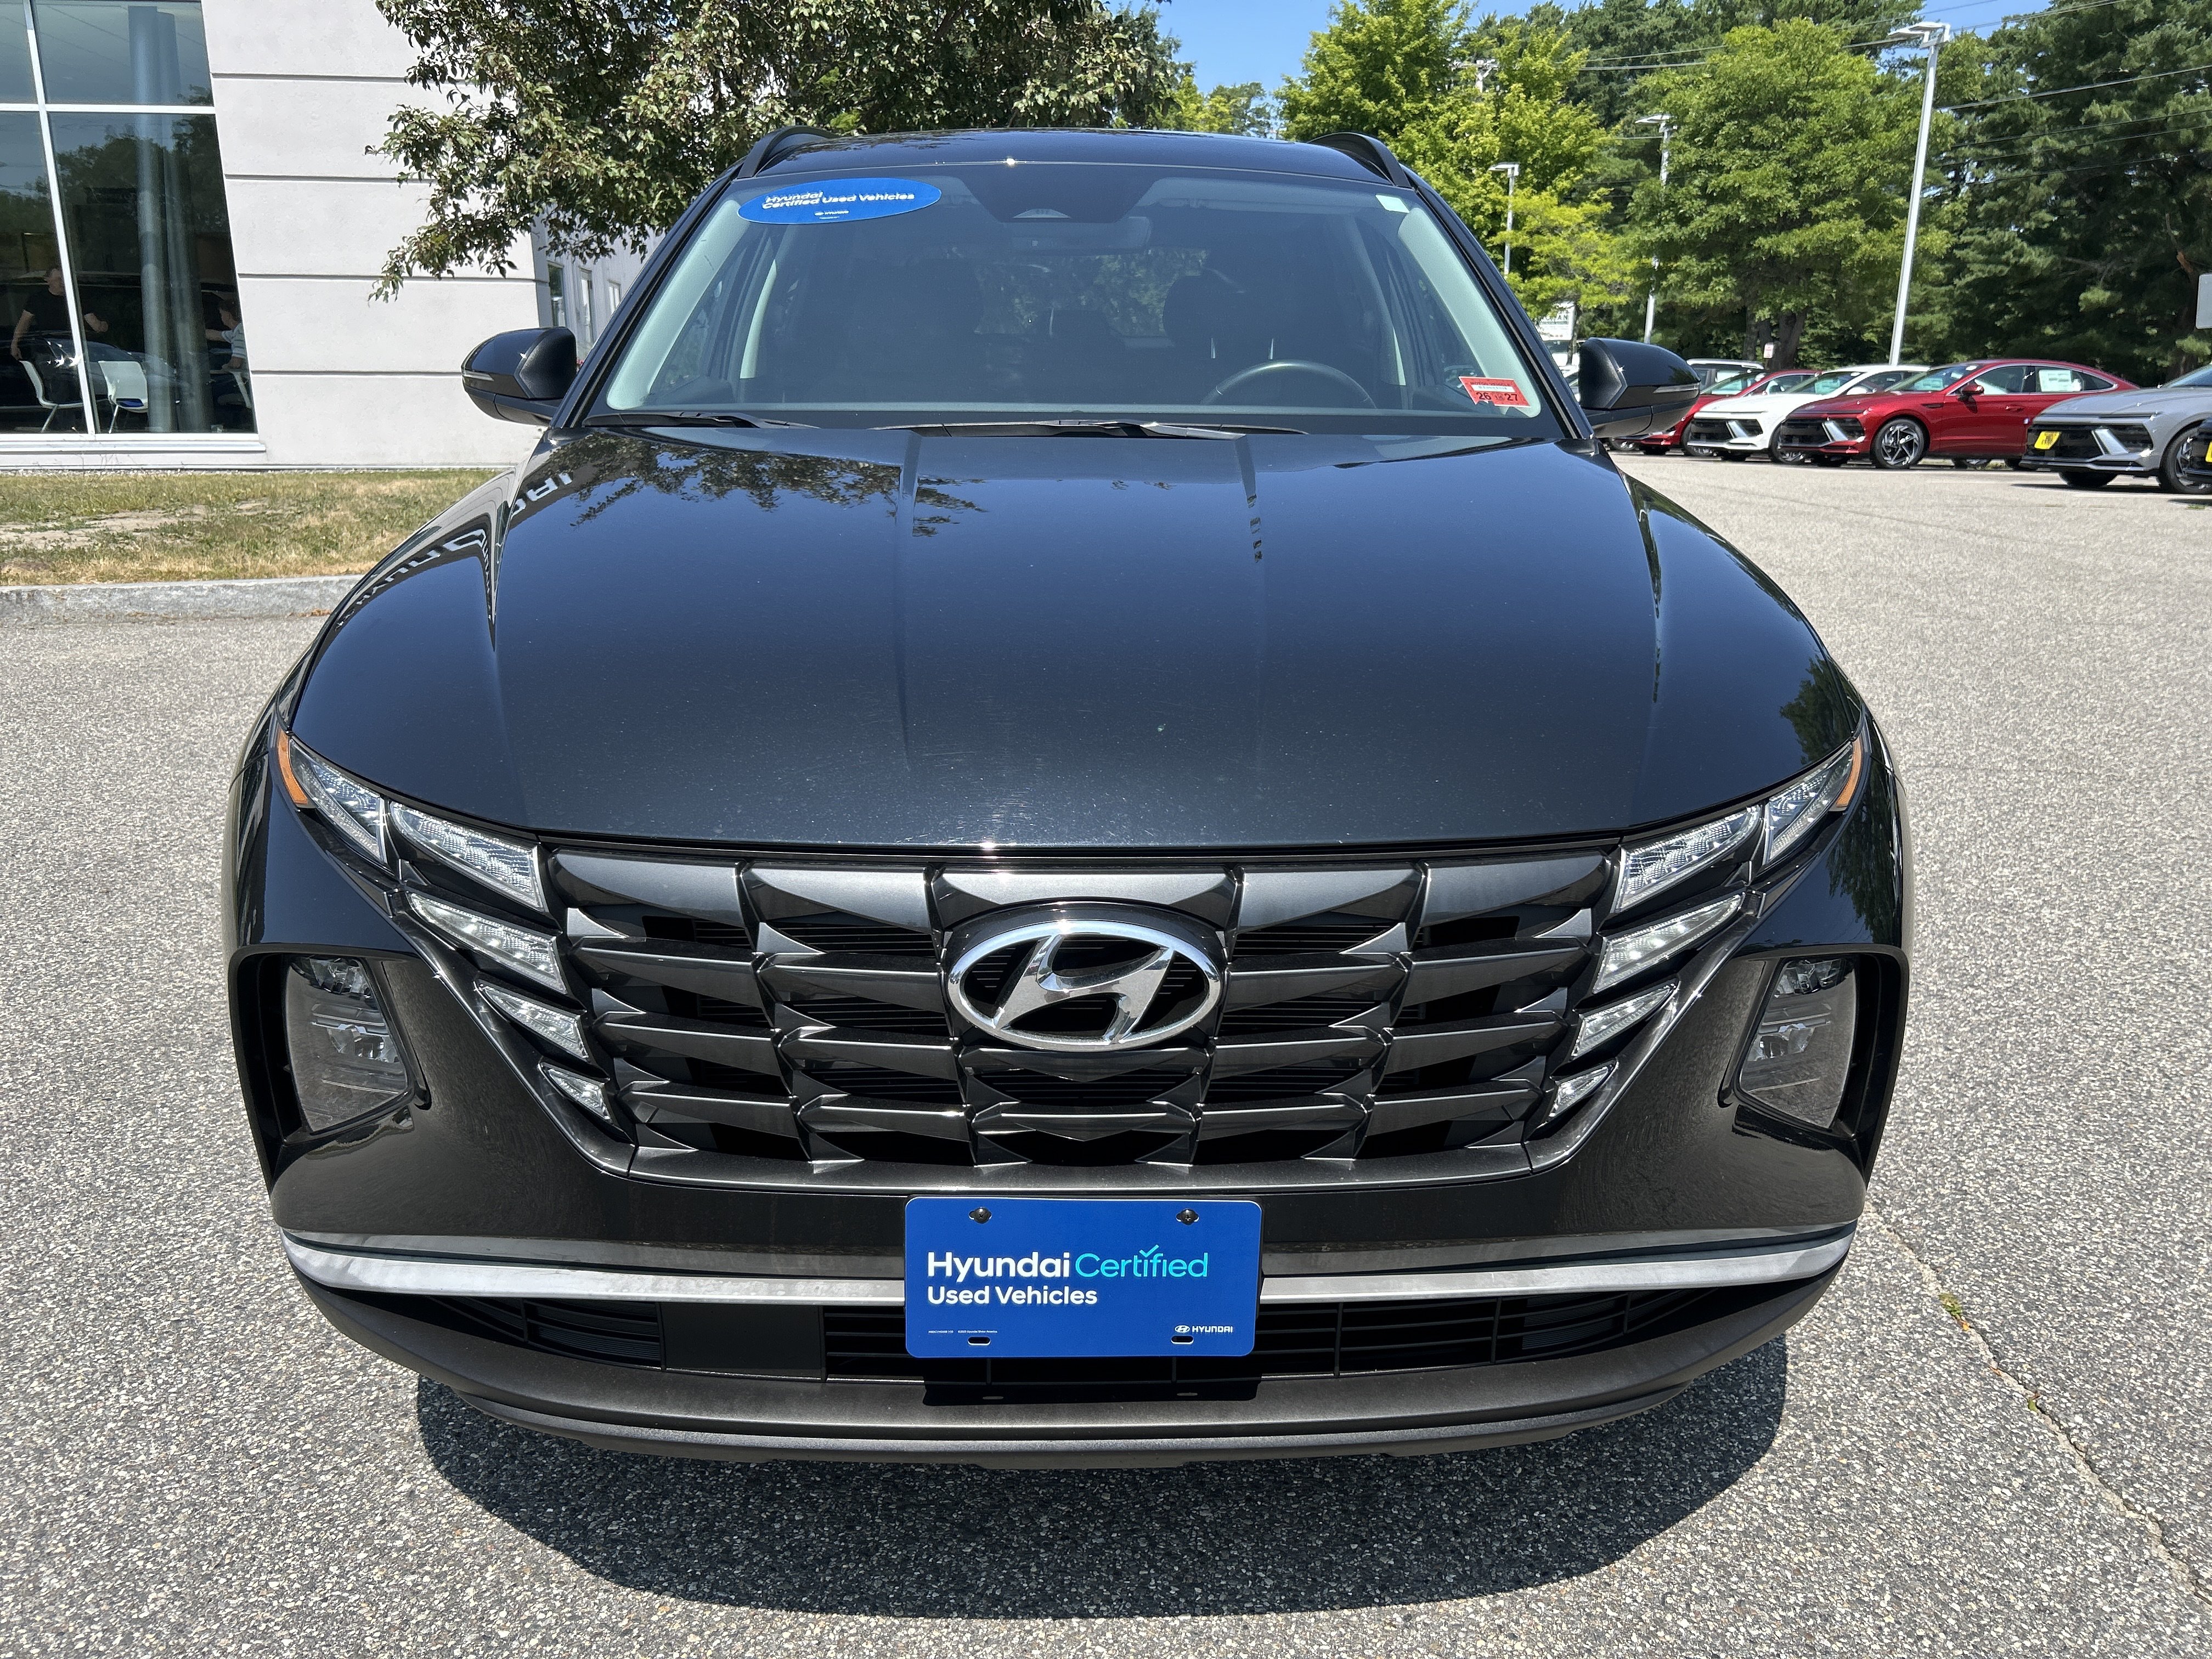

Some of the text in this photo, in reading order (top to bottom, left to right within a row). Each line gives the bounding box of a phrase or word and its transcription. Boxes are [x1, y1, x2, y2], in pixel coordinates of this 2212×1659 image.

[762, 191, 915, 210] Certified Used Vehicles
[765, 191, 823, 202] Hyundai
[1476, 392, 1492, 400] 26
[1504, 393, 1518, 401] 27
[928, 1245, 1208, 1283] Hyundai Certified
[928, 1285, 1098, 1305] Used Vehicles
